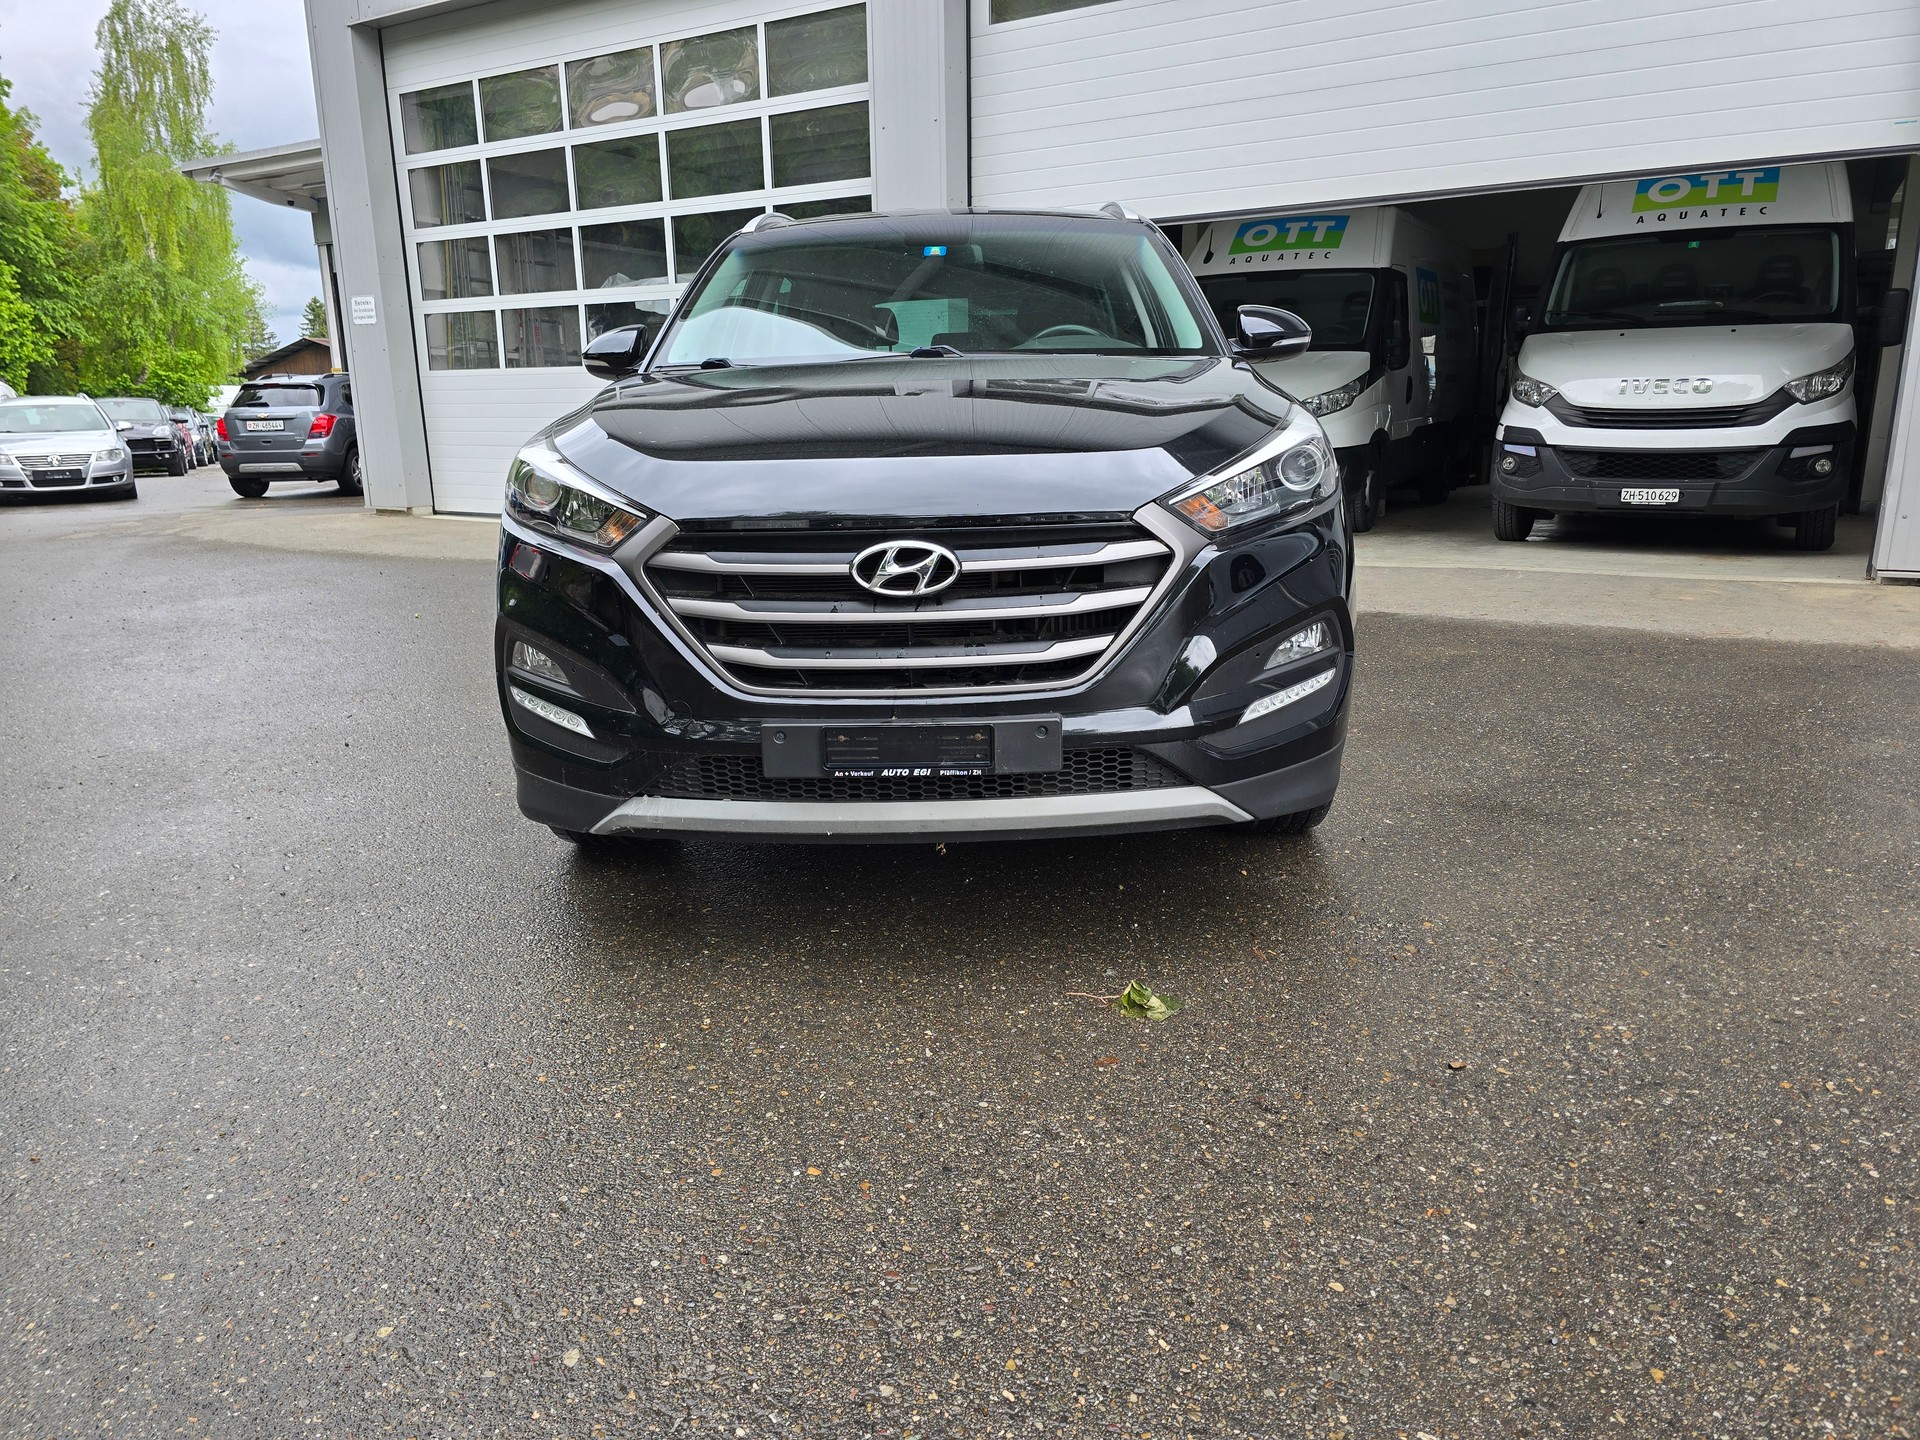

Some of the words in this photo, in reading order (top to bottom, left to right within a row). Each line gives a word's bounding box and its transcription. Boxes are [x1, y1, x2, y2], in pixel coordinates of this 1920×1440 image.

[1647, 171, 1764, 203] OTT
[1636, 206, 1767, 224] AQUATEC
[1243, 221, 1336, 247] OTT
[1229, 251, 1331, 265] AQUATEC
[1618, 378, 1713, 395] IVECO
[881, 768, 909, 777] AUTO
[913, 768, 931, 776] EGI
